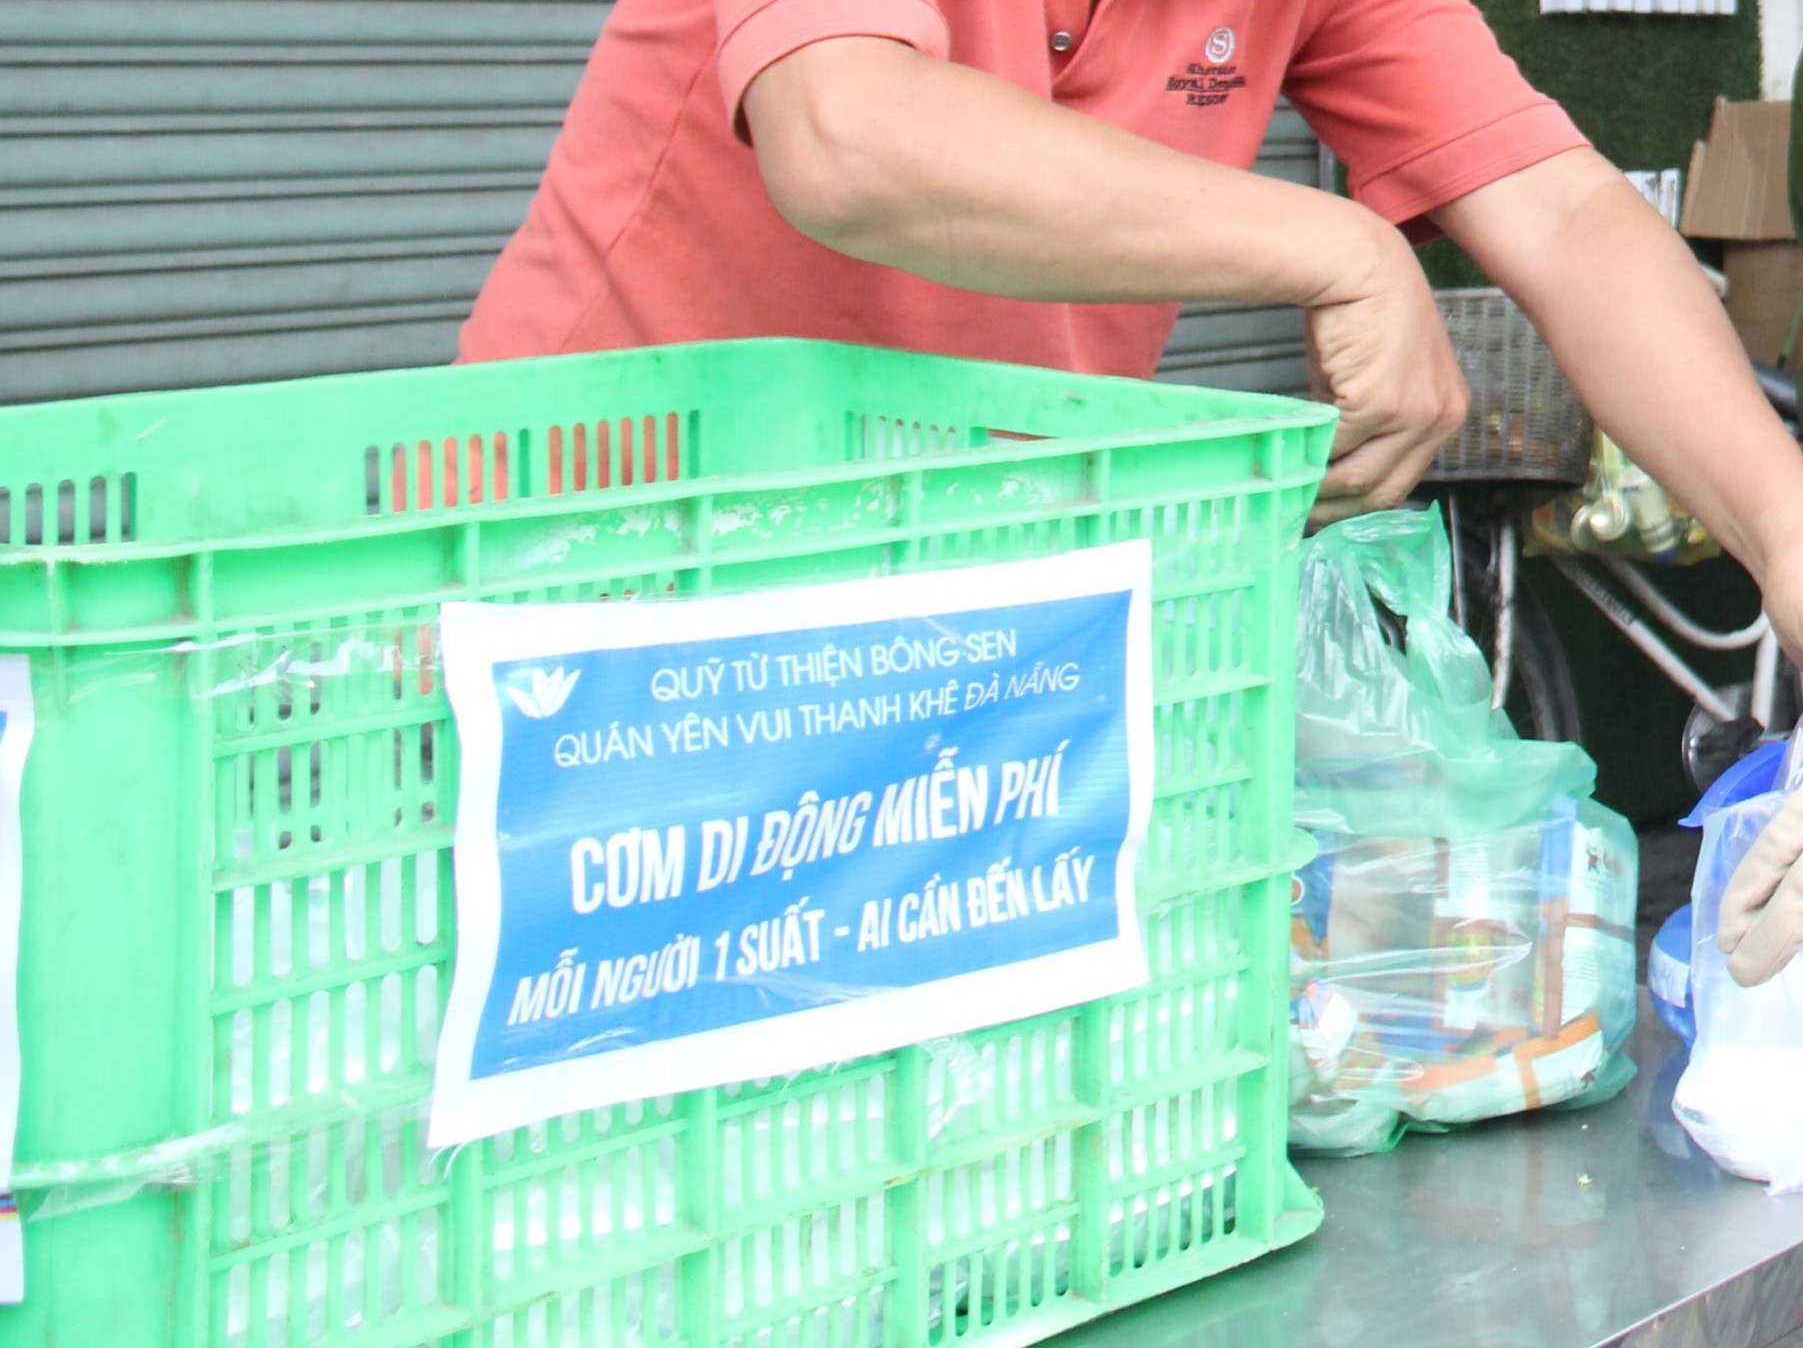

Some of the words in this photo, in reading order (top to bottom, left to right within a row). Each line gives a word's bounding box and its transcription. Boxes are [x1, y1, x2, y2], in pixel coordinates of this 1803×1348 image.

[554, 720, 654, 768] QUÁN
[660, 712, 729, 753] YÊN
[736, 708, 792, 744] VUI
[799, 693, 901, 736] THANH
[909, 679, 961, 721] KHÊ
[963, 672, 1000, 710] ĐÀ
[1003, 661, 1081, 700] NẴNG
[651, 656, 726, 701] QUỸ
[731, 652, 769, 692] TỪ
[775, 643, 863, 688] THIỆN
[870, 635, 960, 676] BÔNG
[966, 628, 1017, 663] SEN
[570, 825, 686, 915] CƠM
[696, 815, 749, 893] DI
[750, 790, 873, 881] ĐỘNG
[872, 745, 989, 847] MIỄN
[993, 738, 1072, 825] PHÍ
[506, 947, 587, 1027] MỖI
[589, 932, 701, 1010] NGƯỜI
[714, 930, 731, 983] 1
[736, 895, 826, 977] SUẤT
[857, 897, 893, 953] AI
[898, 872, 962, 943] CẦN
[966, 855, 1031, 928] ĐẾN
[1032, 845, 1097, 913] LẤY
